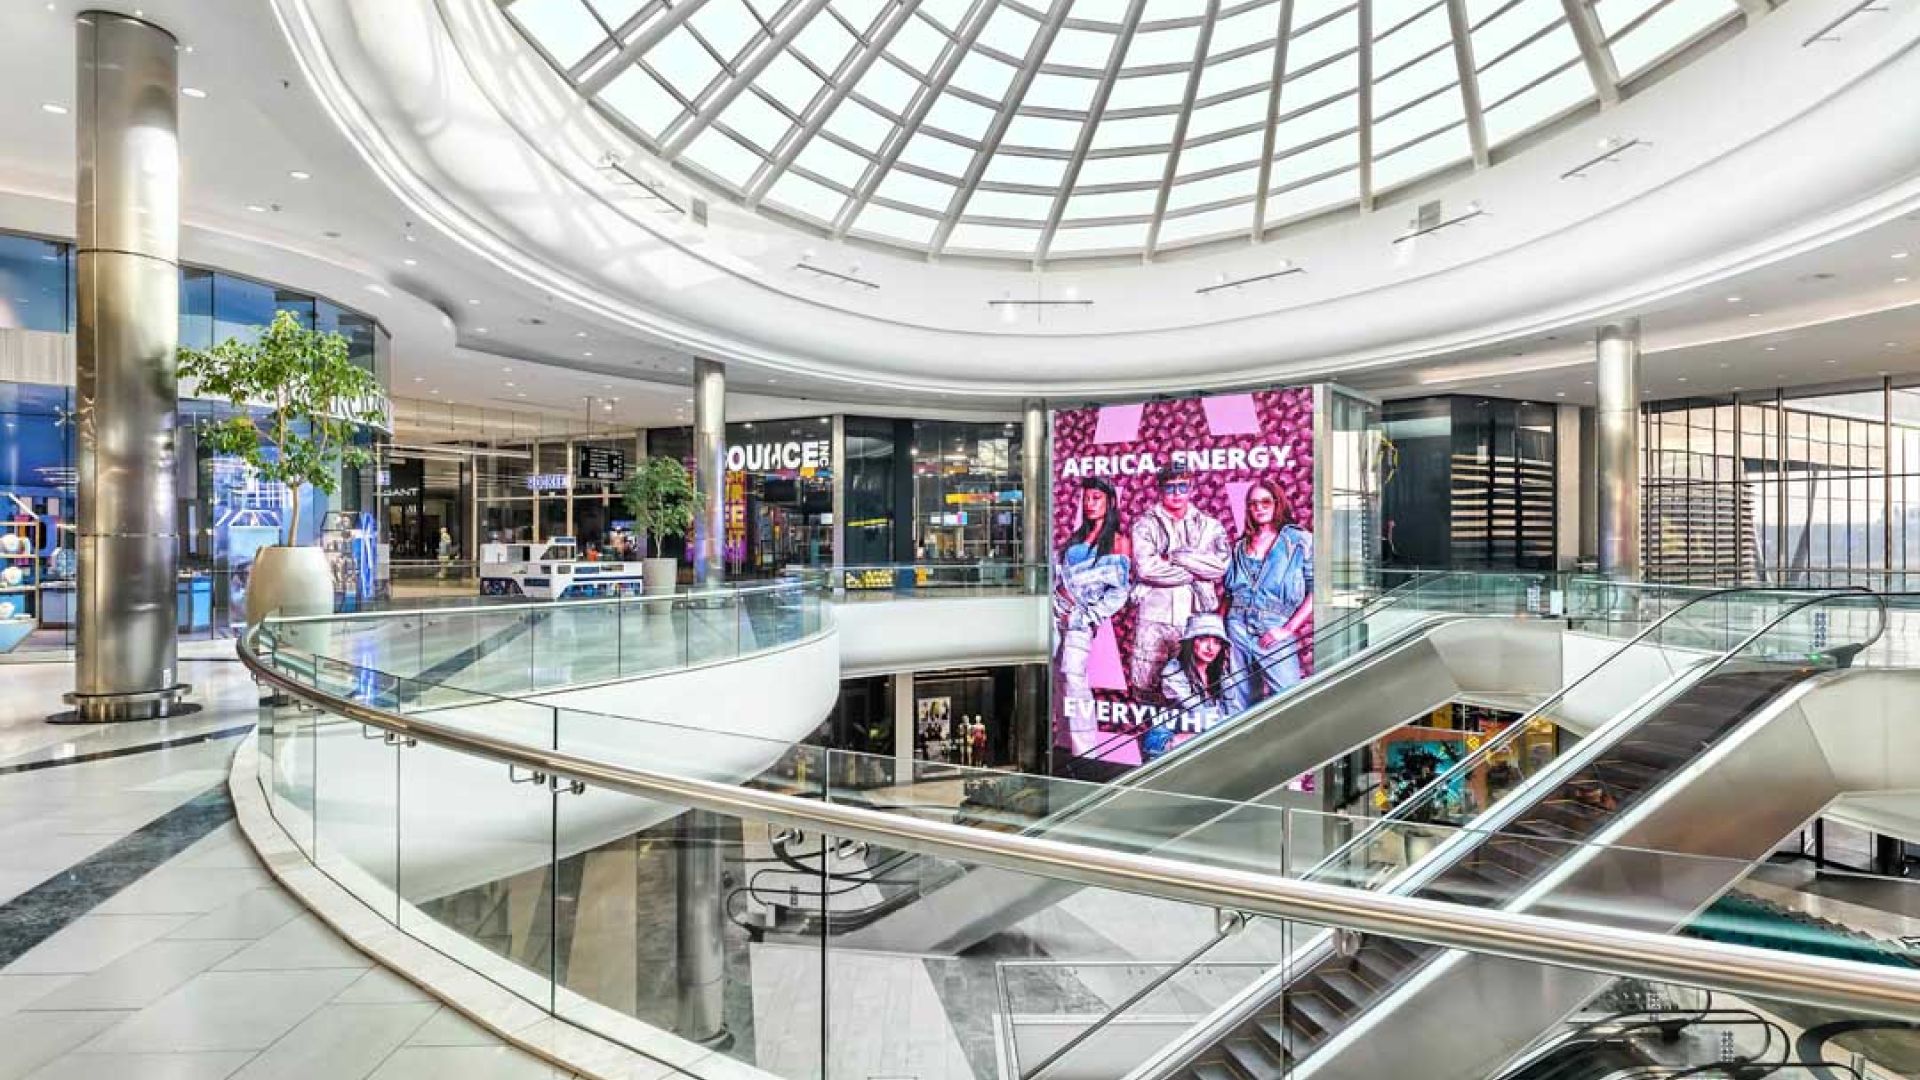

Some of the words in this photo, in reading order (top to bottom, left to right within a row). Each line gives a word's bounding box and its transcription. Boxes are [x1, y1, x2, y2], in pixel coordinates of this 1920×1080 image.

[727, 441, 819, 471] OUNCE
[1062, 453, 1163, 477] AFRICA.
[1171, 445, 1296, 472] ENERGY.
[1064, 697, 1219, 733] EVERYWHE
